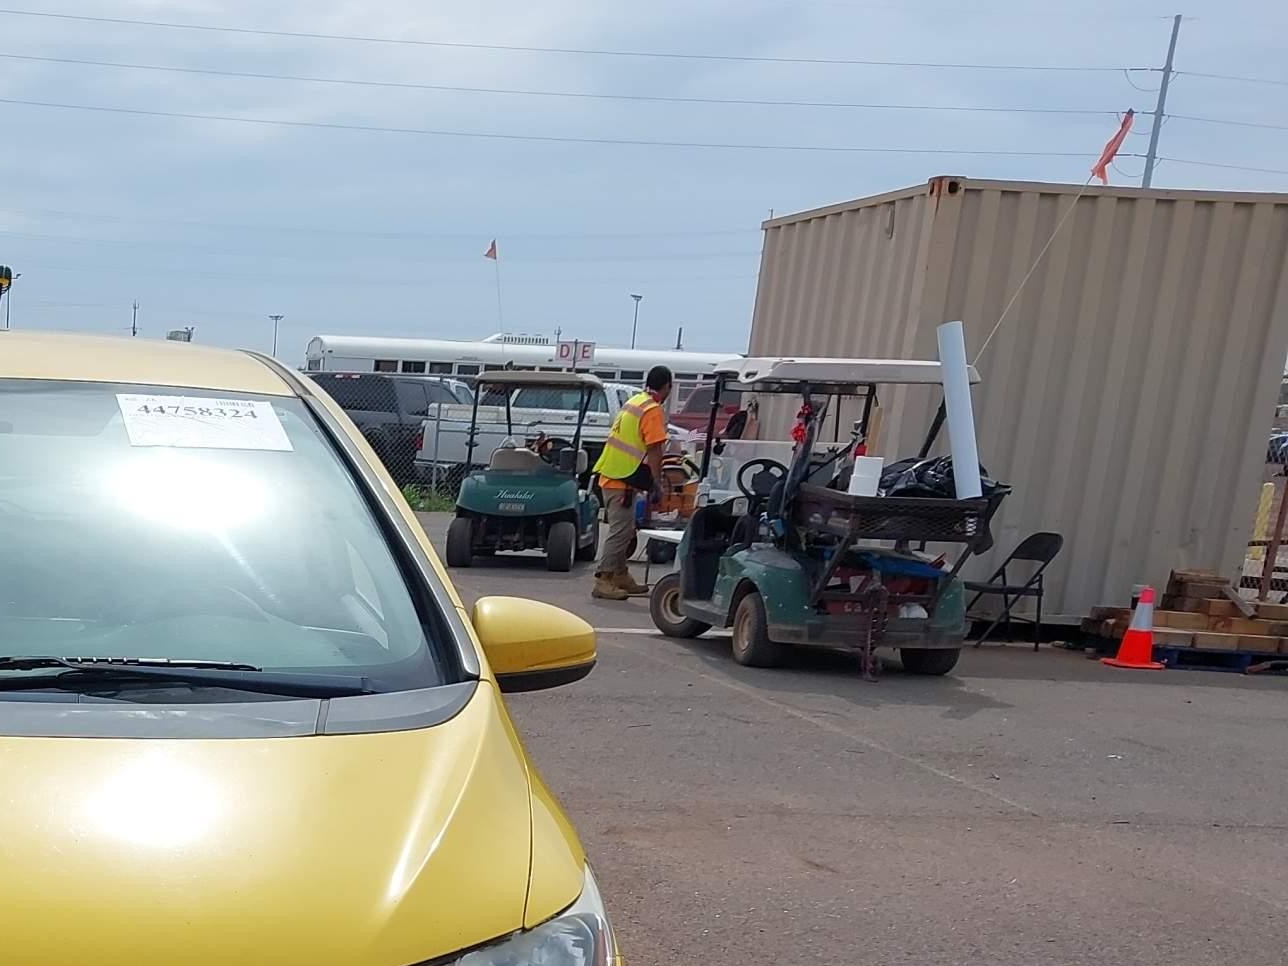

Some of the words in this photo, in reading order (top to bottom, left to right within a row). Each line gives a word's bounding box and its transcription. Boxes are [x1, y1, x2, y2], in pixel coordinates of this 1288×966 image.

[560, 344, 570, 358] D
[582, 344, 591, 359] E
[137, 404, 259, 420] 44758324
